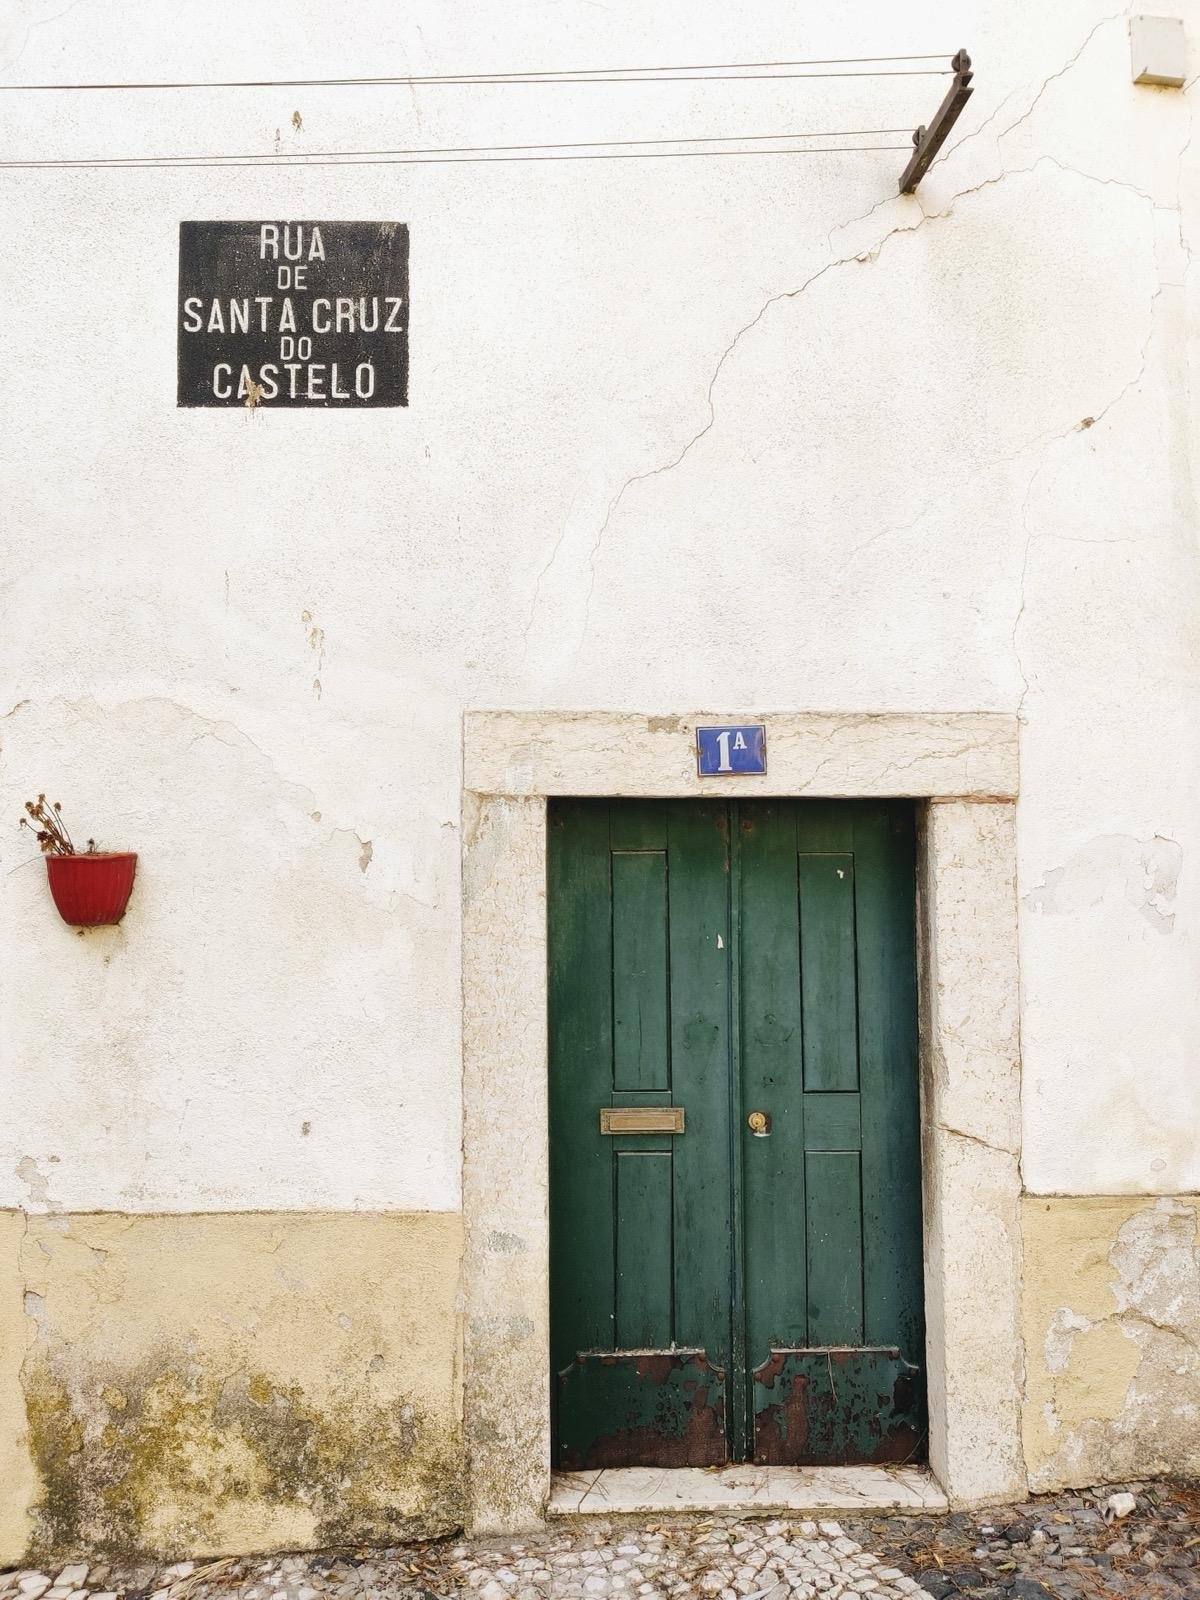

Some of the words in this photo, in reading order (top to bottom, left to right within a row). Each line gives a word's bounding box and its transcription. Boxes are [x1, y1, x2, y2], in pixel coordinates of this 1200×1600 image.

[259, 224, 326, 261] RUA
[277, 265, 308, 290] DE
[183, 297, 297, 334] SANTA
[312, 297, 403, 333] CRUZ
[280, 336, 312, 360] DO
[213, 362, 375, 399] CASTELO
